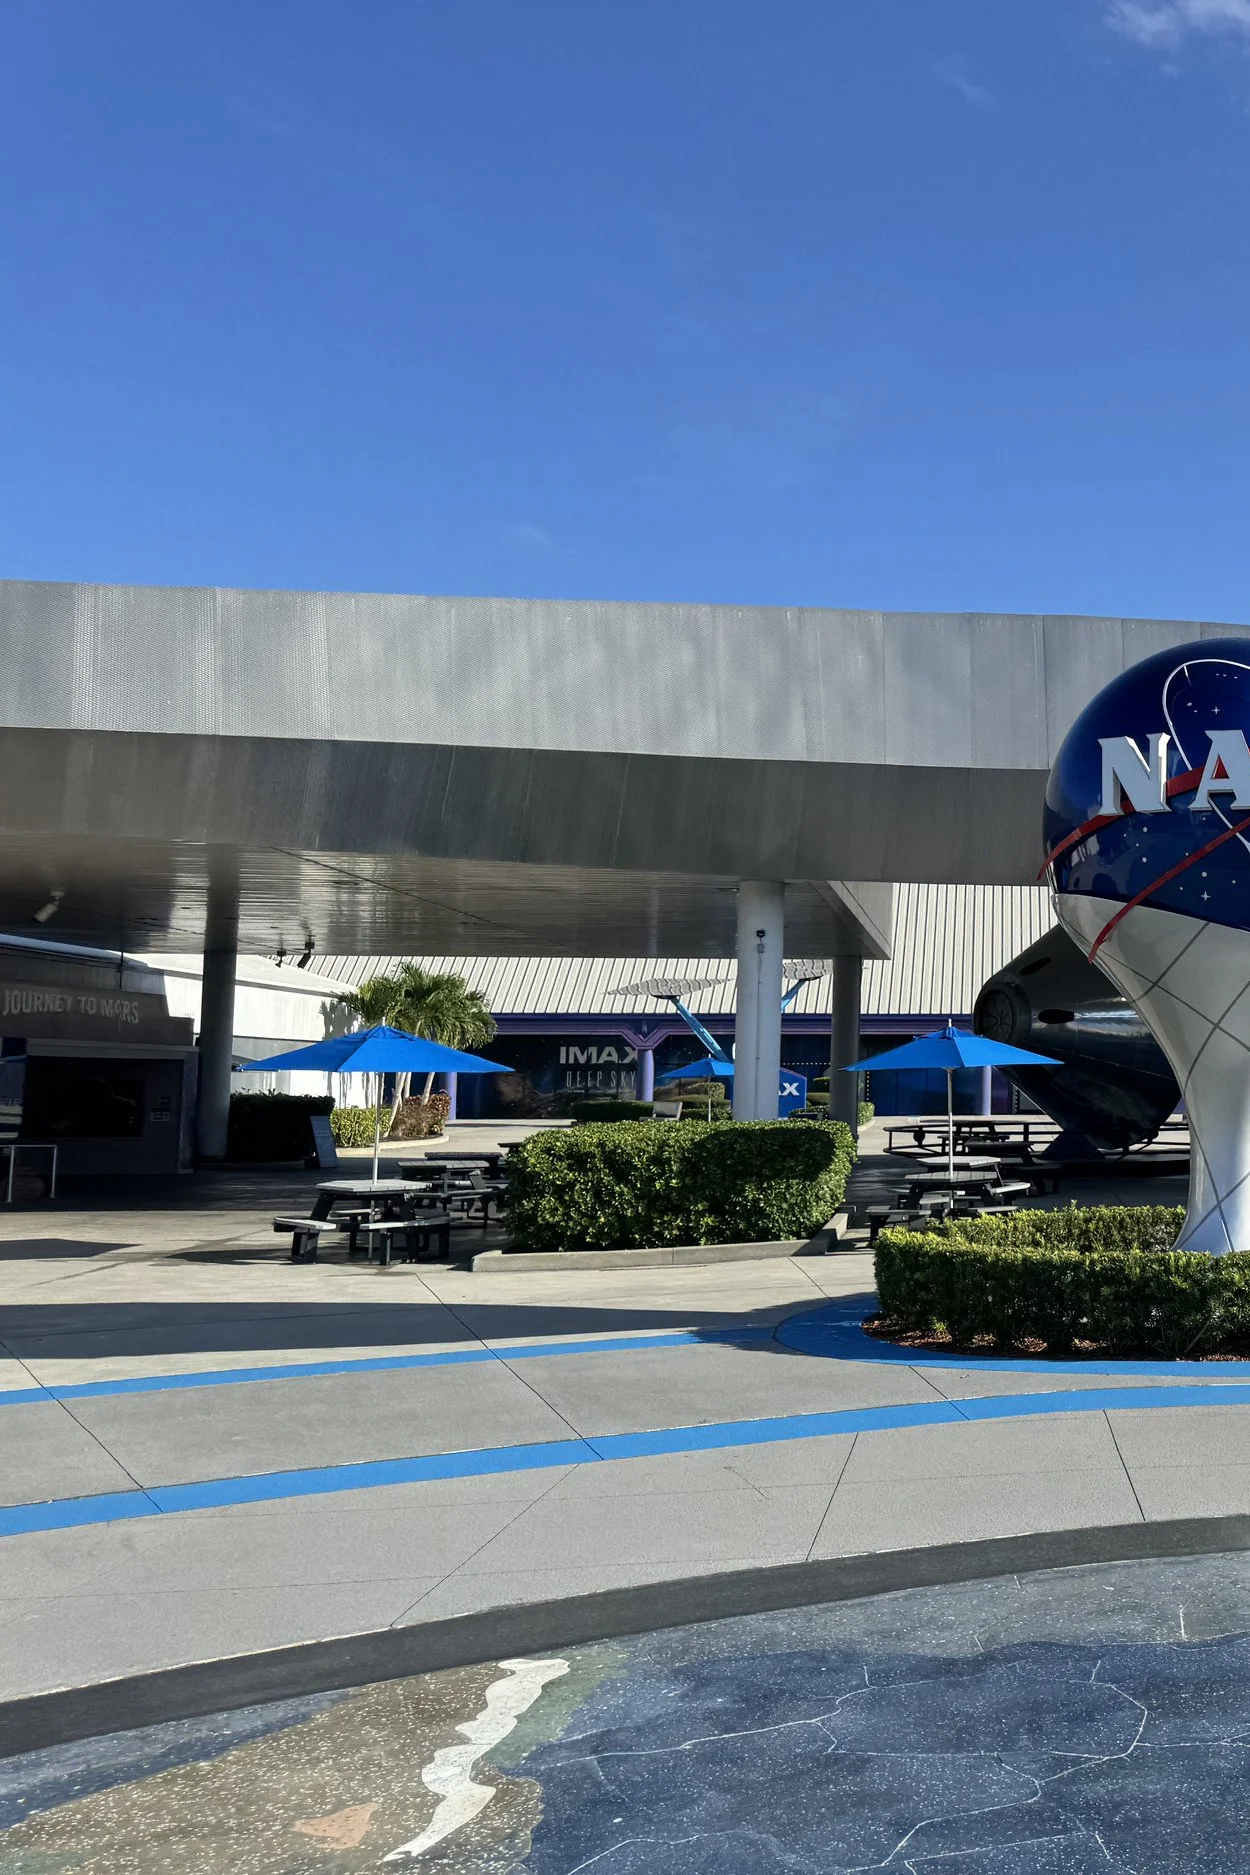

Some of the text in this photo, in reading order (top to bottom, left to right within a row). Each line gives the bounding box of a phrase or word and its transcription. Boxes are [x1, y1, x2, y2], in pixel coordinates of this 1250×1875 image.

[3, 990, 139, 1024] JOURNEY TO MARS
[560, 1046, 638, 1064] IMAX
[566, 1070, 636, 1088] DEEP SKY
